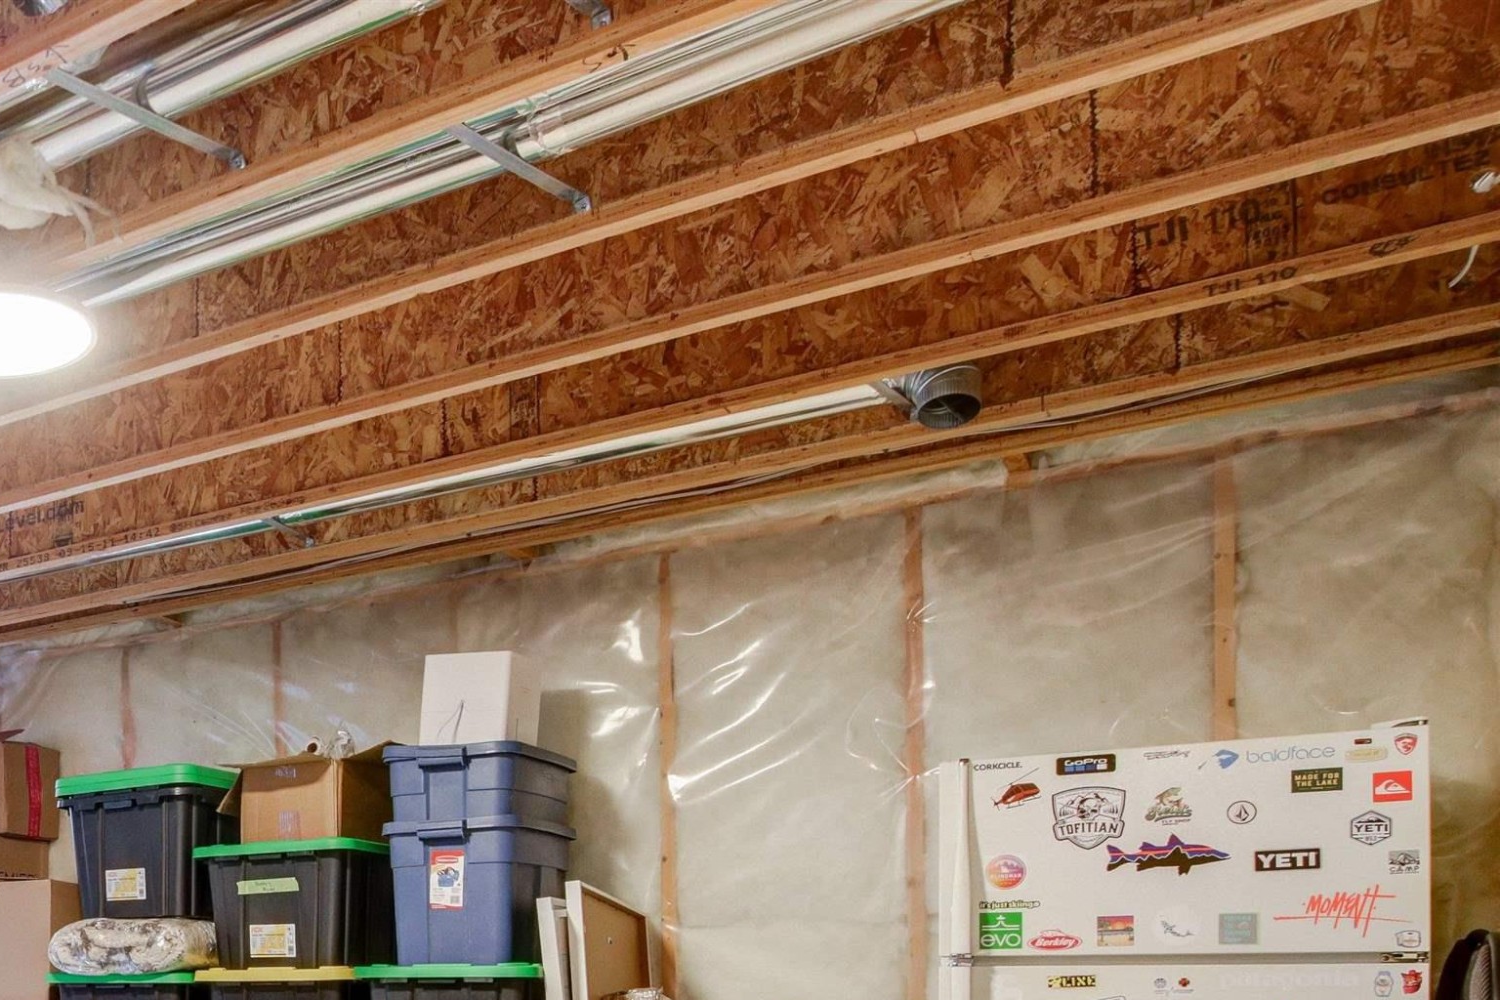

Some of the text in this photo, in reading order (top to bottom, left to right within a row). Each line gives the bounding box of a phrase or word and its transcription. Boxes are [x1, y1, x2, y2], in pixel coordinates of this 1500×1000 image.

[1246, 745, 1336, 764] baldface
[1064, 758, 1108, 767] GoPro
[1294, 772, 1340, 782] MADE FOR
[1296, 778, 1338, 788] THE LAKE
[1058, 822, 1119, 836] TOFITIAN
[1354, 824, 1389, 833] YETI
[1257, 852, 1319, 869] YETI
[981, 933, 1022, 947] evo
[1035, 935, 1075, 949] Berkley
